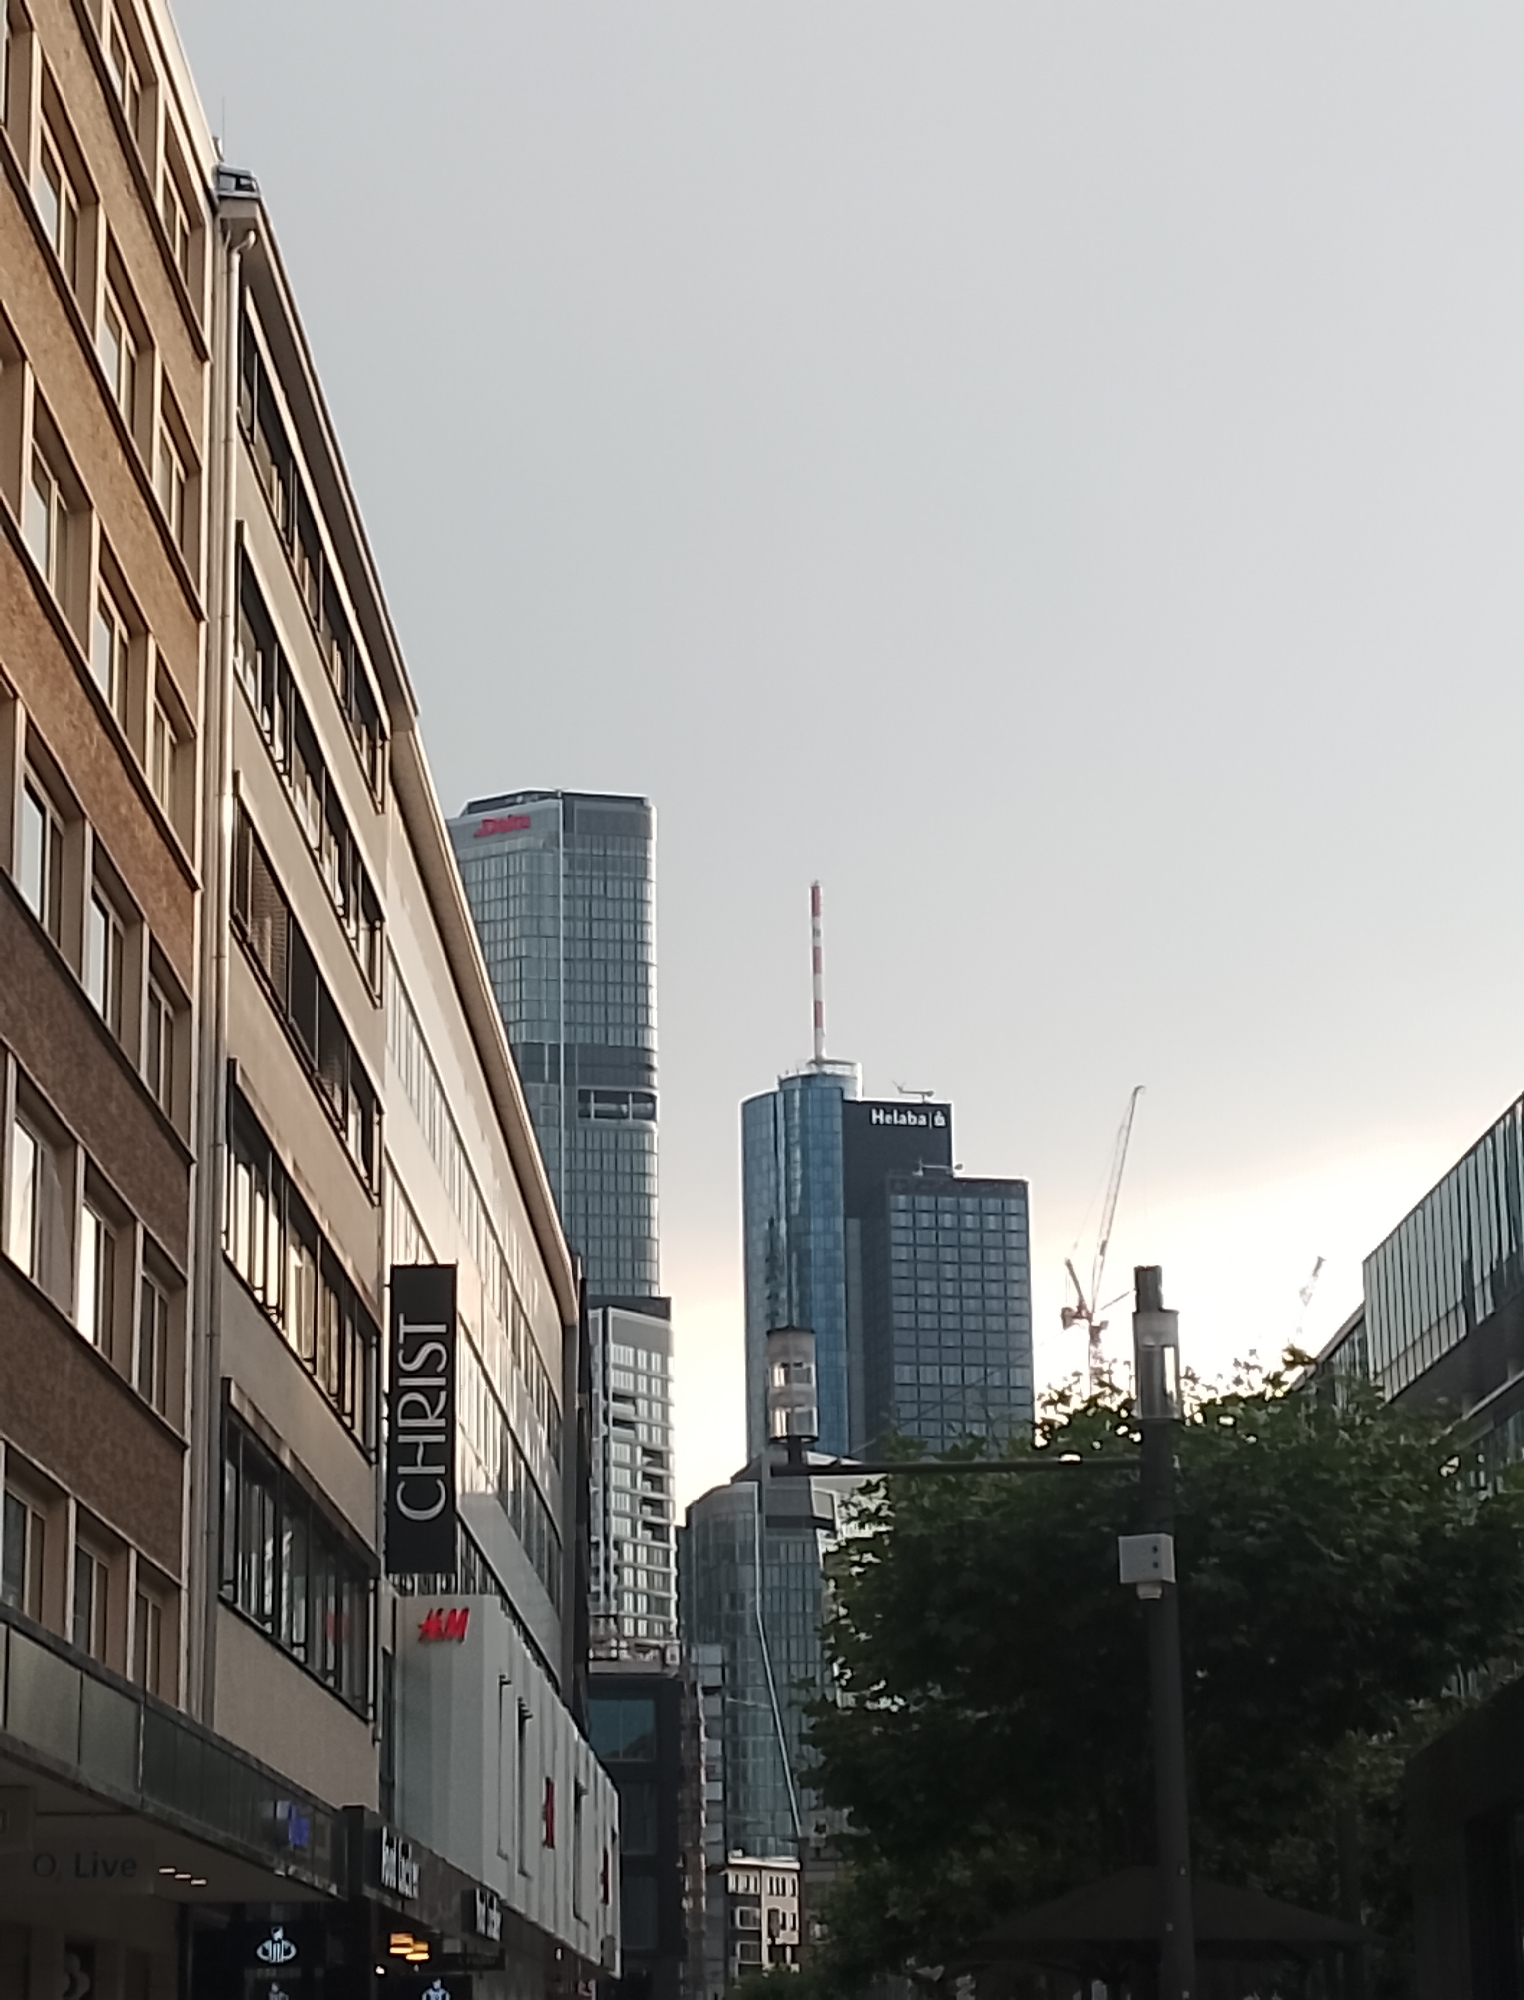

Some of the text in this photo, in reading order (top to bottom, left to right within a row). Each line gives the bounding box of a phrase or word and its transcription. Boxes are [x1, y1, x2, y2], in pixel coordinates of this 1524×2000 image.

[871, 1108, 927, 1126] Helaba
[396, 1313, 449, 1522] CHRIST
[75, 1851, 137, 1878] Live
